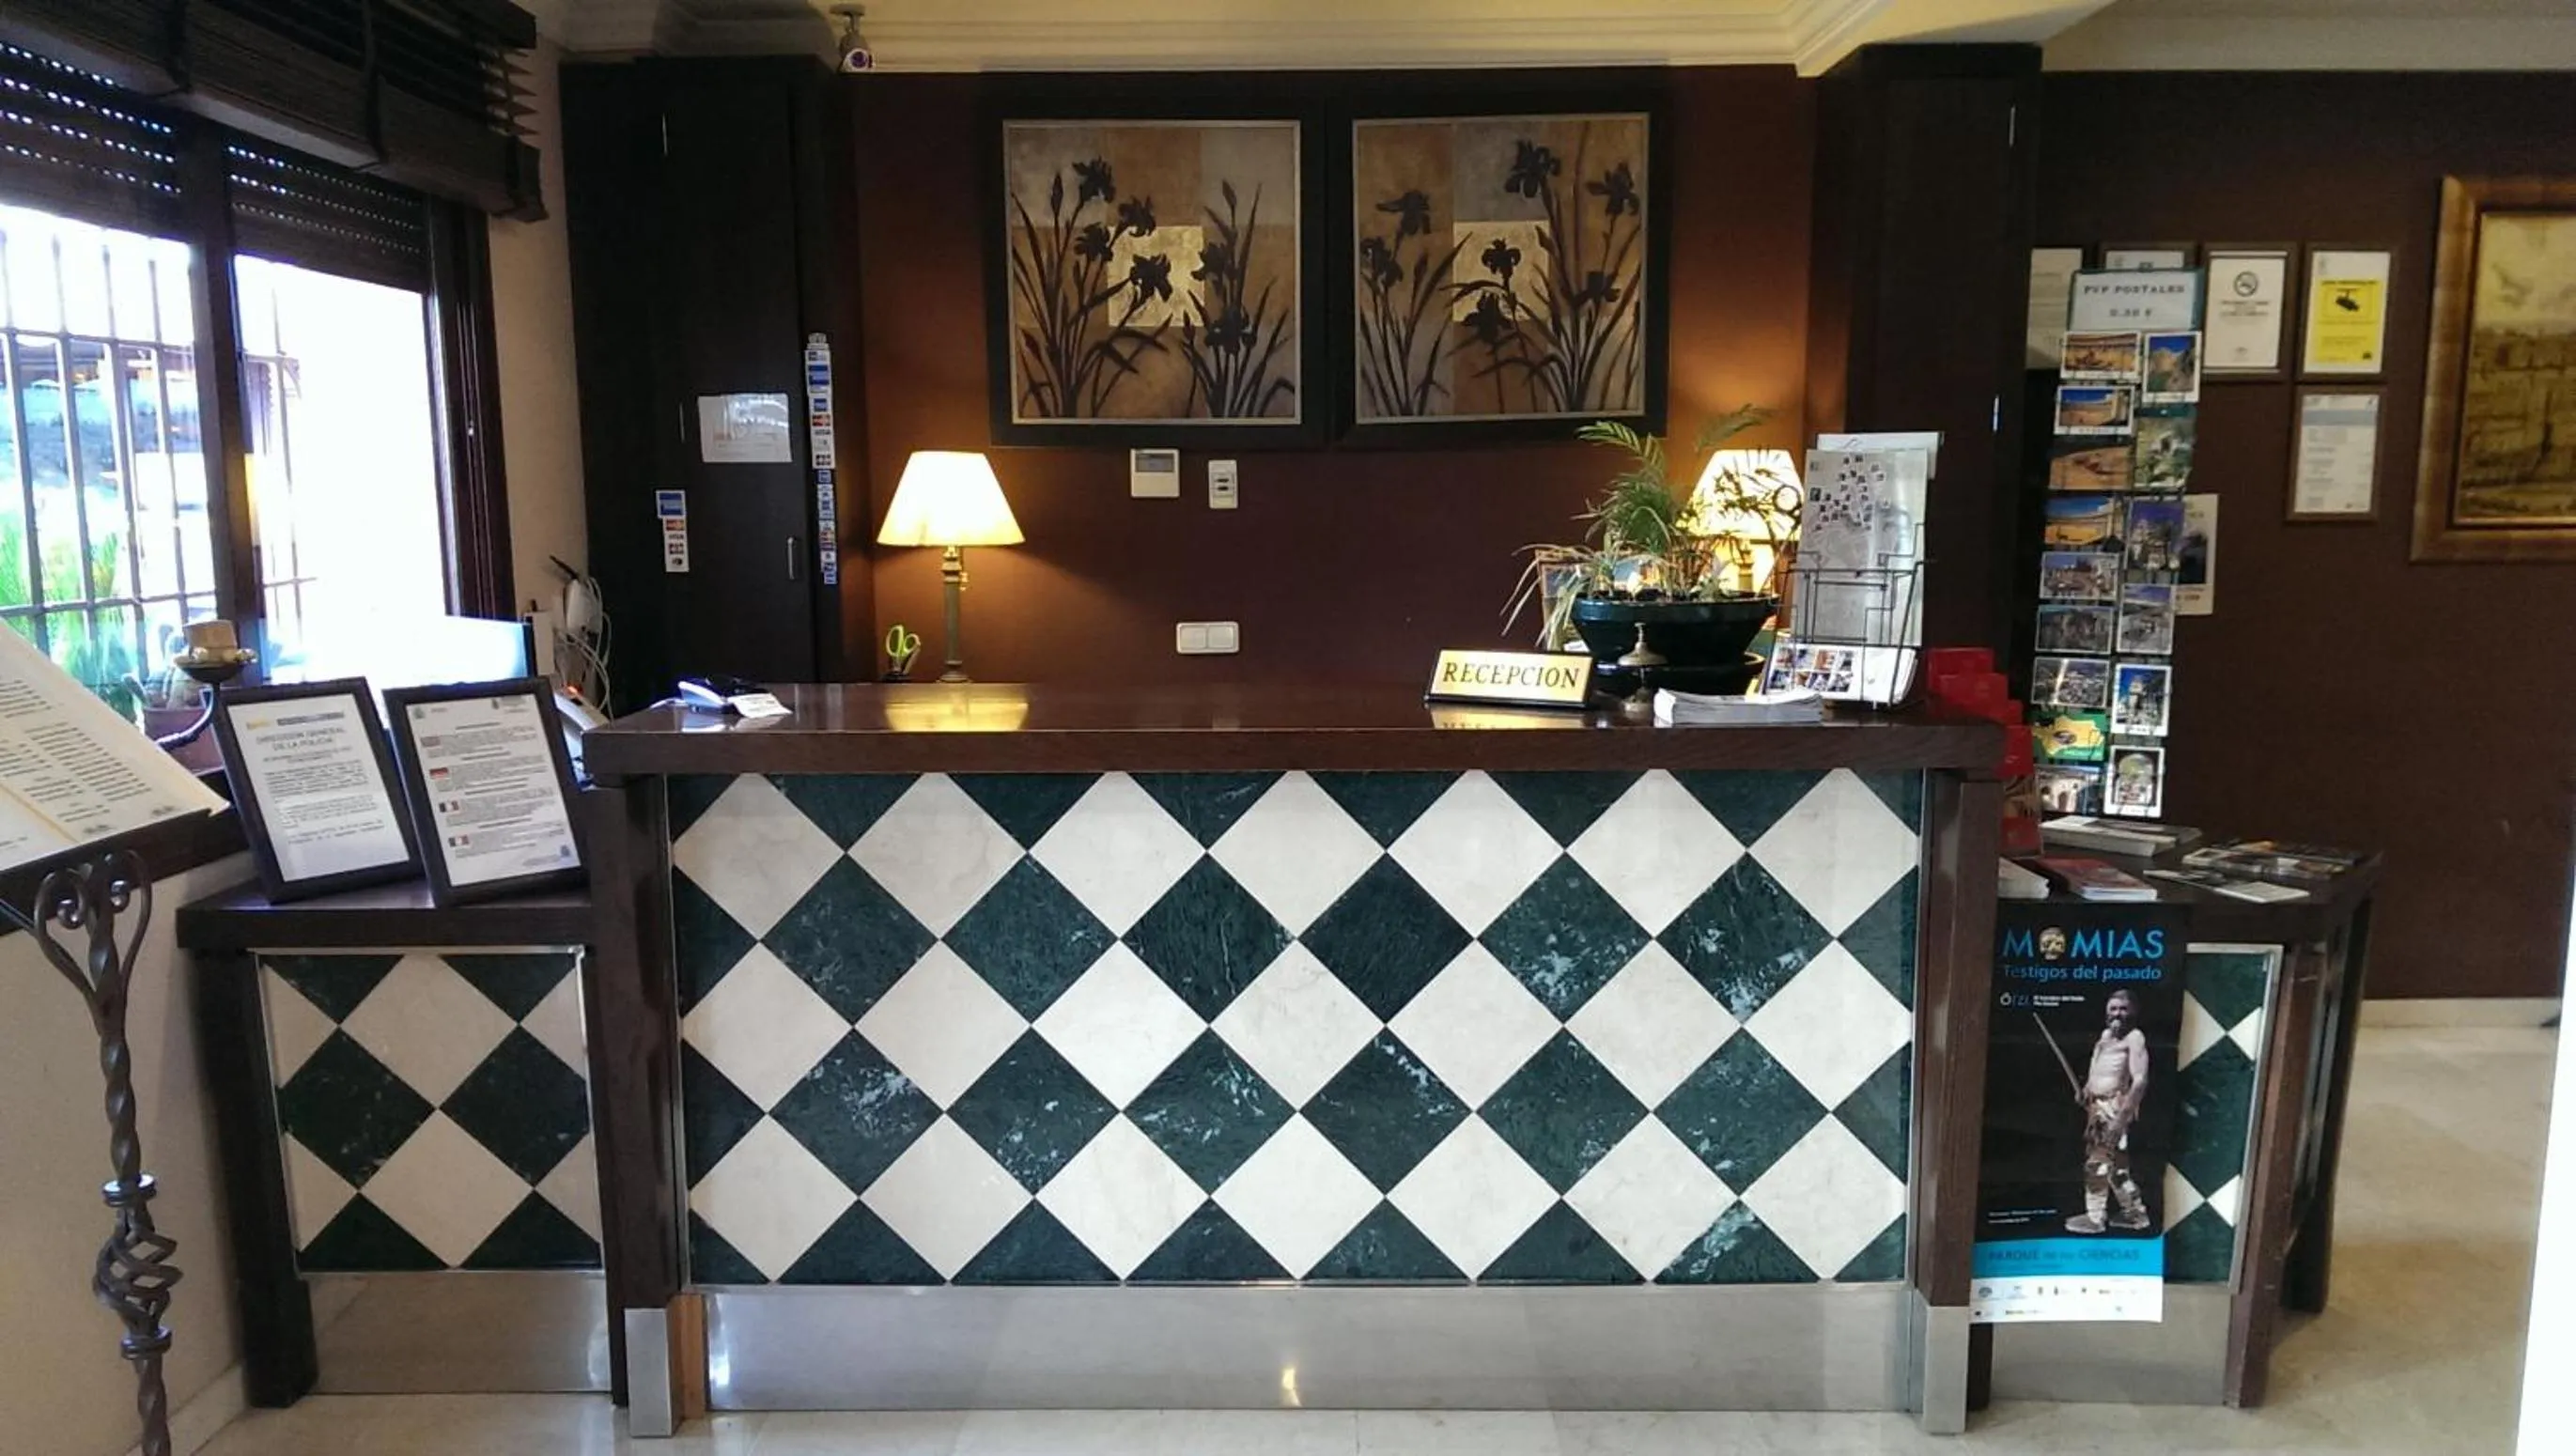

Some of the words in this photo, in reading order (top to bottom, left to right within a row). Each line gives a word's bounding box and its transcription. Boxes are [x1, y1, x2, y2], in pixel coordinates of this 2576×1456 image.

[2114, 285, 2185, 295] POSTALES
[1442, 661, 1580, 689] RECEPCION
[2004, 964, 2068, 983] Testigos
[2072, 964, 2098, 980] del
[2102, 965, 2163, 983] pasado
